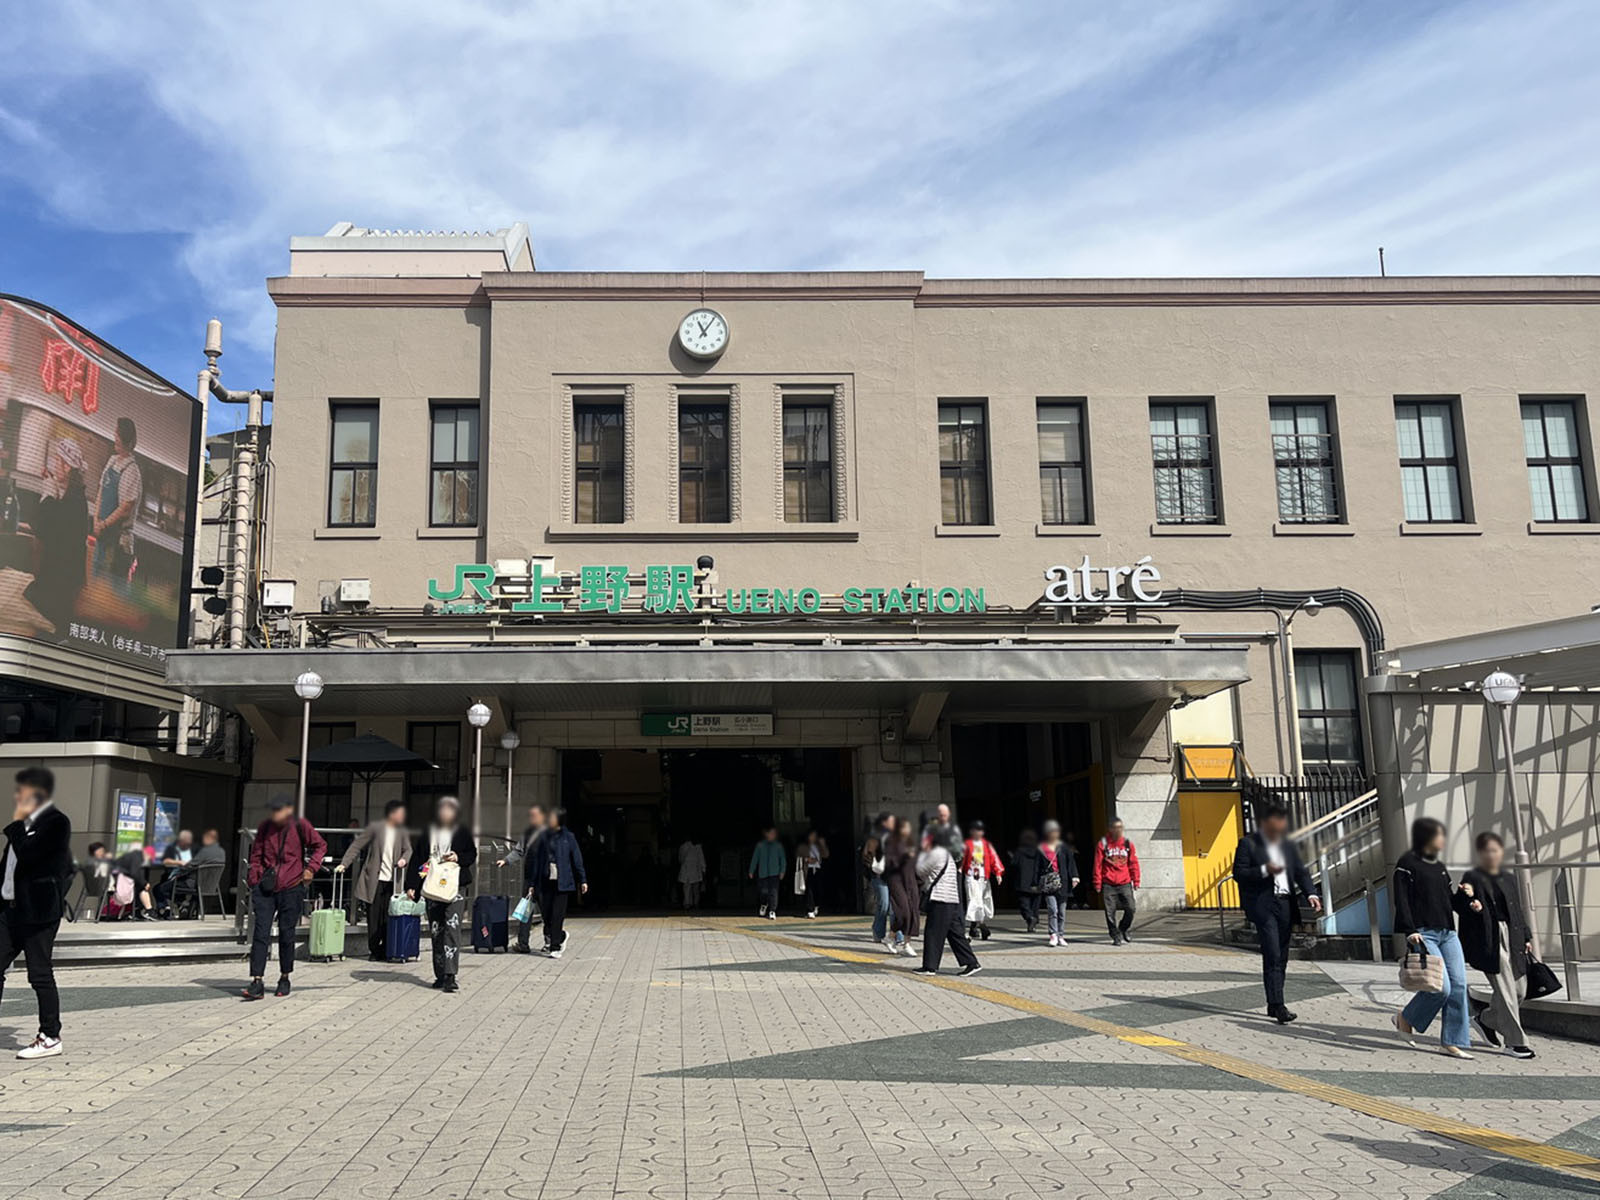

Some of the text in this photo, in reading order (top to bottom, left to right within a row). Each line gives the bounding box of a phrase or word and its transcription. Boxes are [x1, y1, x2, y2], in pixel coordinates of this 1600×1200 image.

[427, 564, 985, 613] JR 上野駅 UENO STATION
[1044, 555, 1163, 602] atré
[667, 716, 689, 729] JR
[693, 716, 721, 726] 上野駅
